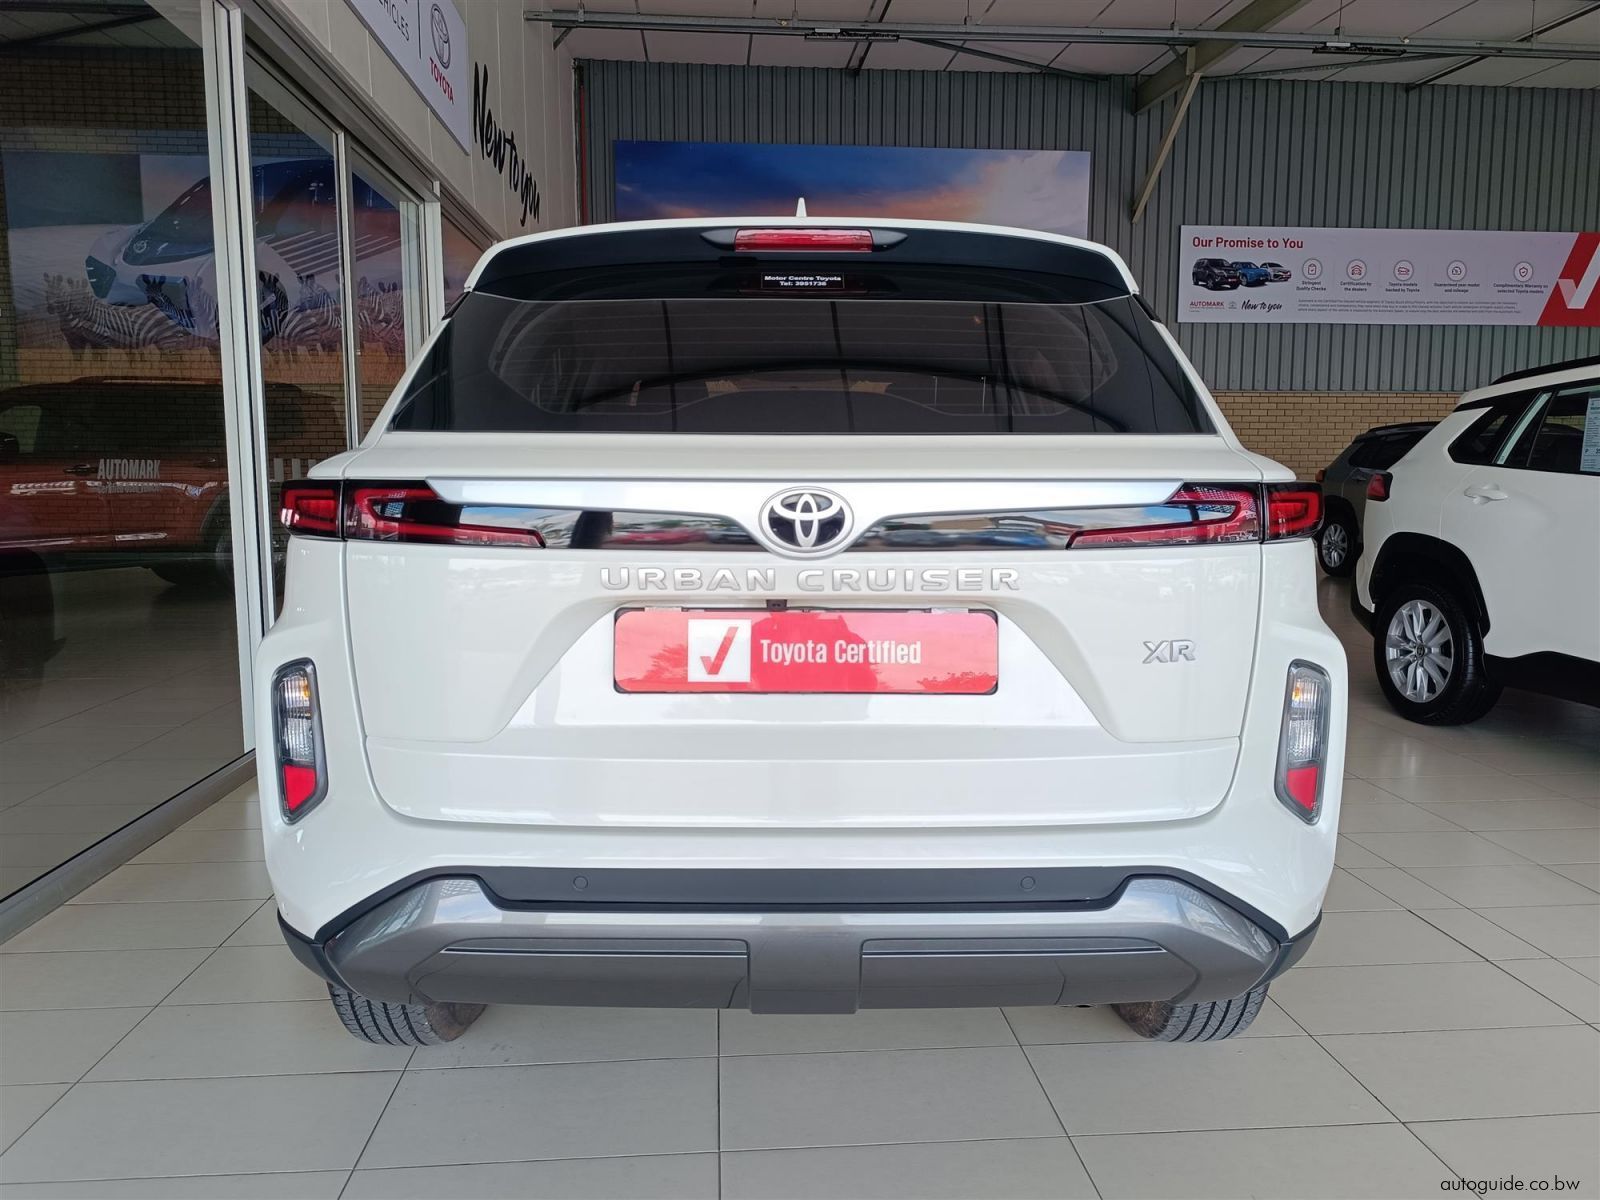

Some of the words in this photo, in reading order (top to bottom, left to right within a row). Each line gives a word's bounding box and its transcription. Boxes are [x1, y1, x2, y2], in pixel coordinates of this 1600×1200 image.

[429, 57, 454, 104] TOYOTA
[473, 61, 505, 174] New
[505, 131, 519, 192] to
[520, 159, 540, 227] you
[1192, 237, 1213, 248] Our
[1216, 237, 1264, 248] Promise
[1267, 238, 1279, 248] to
[1282, 238, 1304, 249] You
[1241, 299, 1259, 310] New
[1259, 302, 1267, 310] to
[1266, 303, 1283, 313] you
[97, 458, 160, 480] AUTOMARK
[600, 567, 777, 591] URBAN
[797, 567, 1021, 591] CRUISER
[760, 639, 827, 665] Toyota
[834, 639, 921, 664] Certified
[1142, 639, 1196, 664] XR
